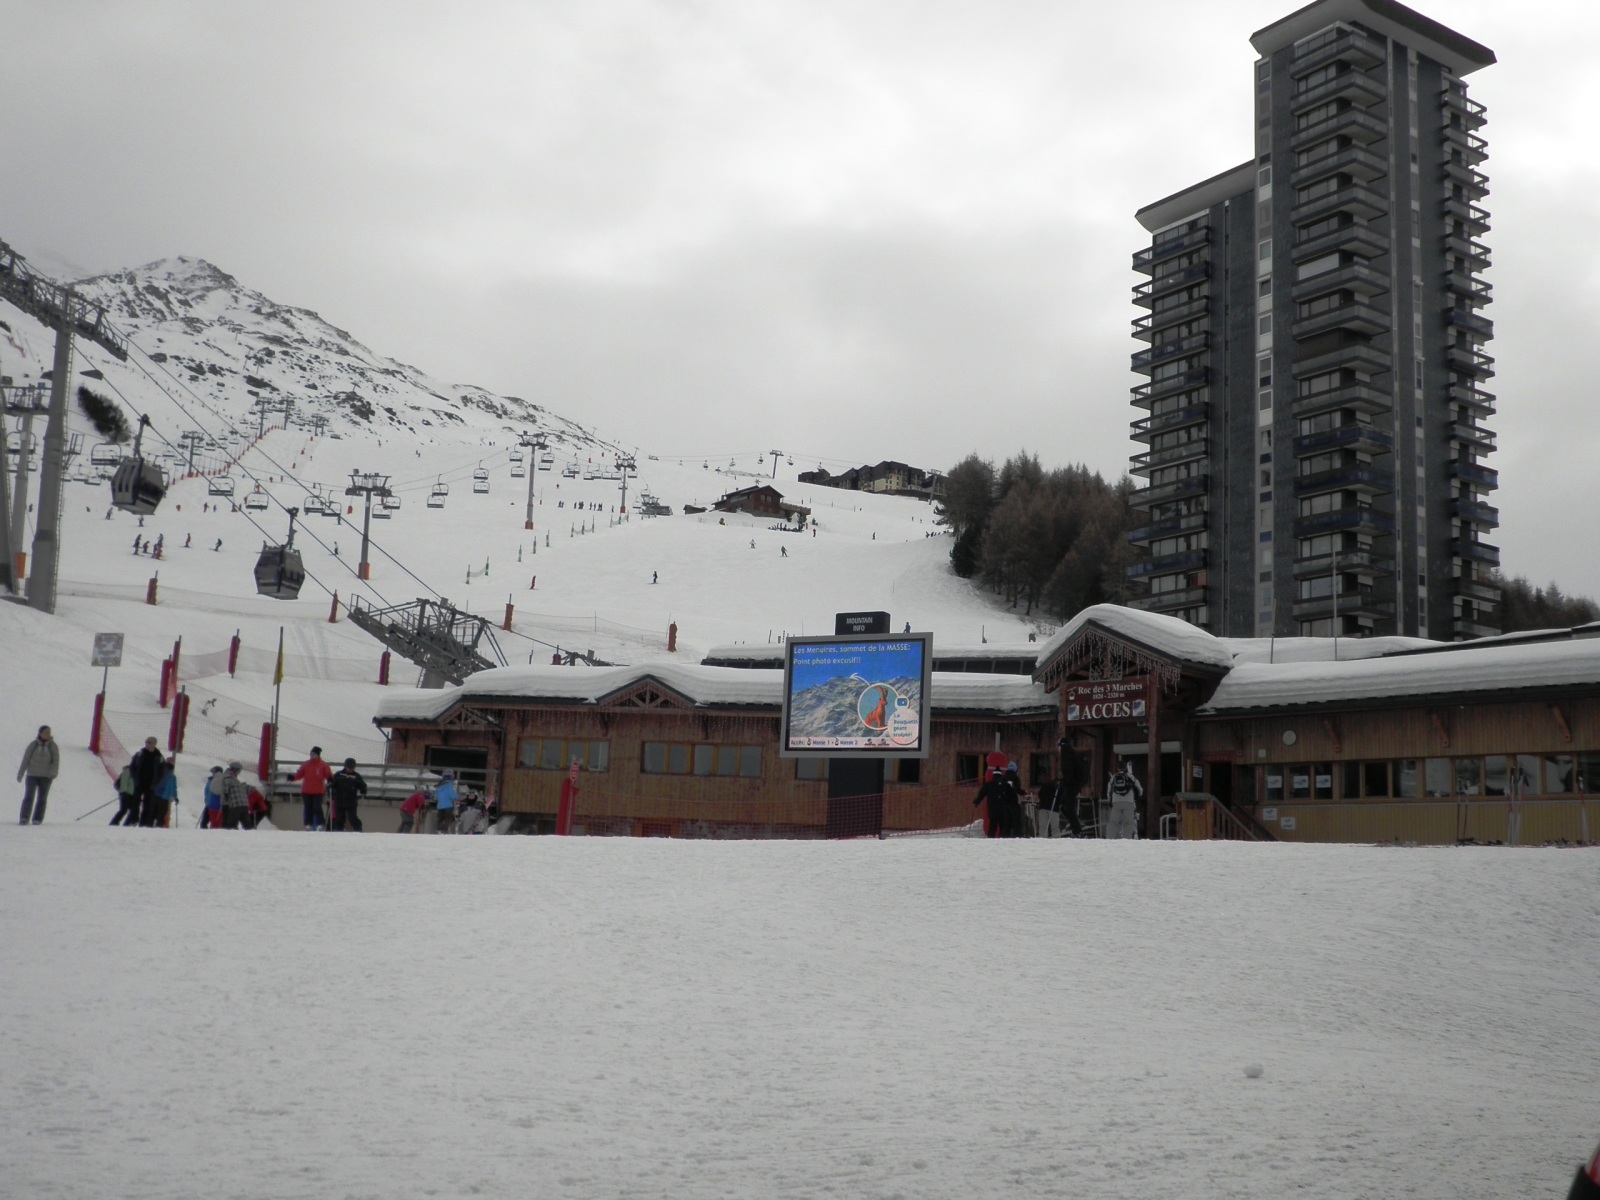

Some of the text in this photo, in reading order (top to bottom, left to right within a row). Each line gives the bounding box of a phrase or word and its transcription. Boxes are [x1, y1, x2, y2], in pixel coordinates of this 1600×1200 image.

[846, 616, 873, 624] MOUNTAIN
[852, 624, 866, 632] INFO
[840, 645, 866, 653] sommet
[868, 644, 877, 652] de
[886, 643, 911, 651] MASSE:
[812, 657, 831, 666] photo
[1078, 682, 1143, 695] Roc des 3 Marches
[1081, 701, 1131, 720] ACCES
